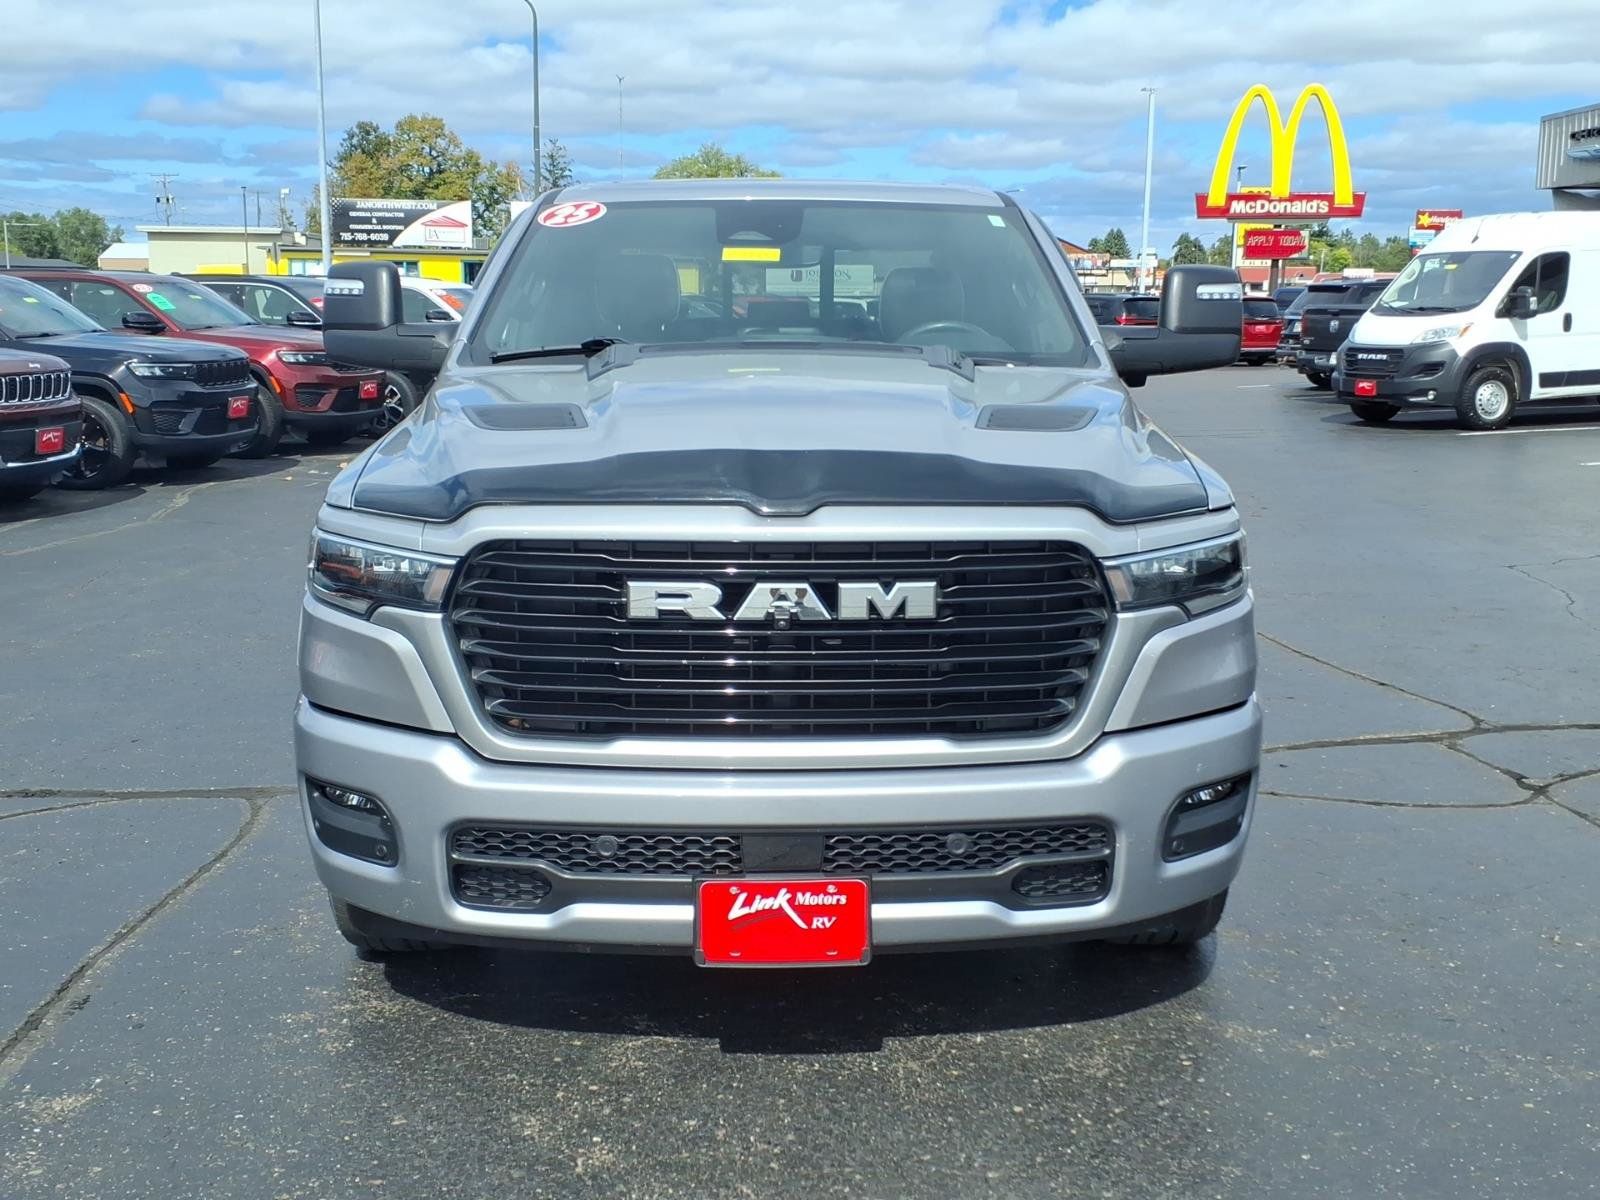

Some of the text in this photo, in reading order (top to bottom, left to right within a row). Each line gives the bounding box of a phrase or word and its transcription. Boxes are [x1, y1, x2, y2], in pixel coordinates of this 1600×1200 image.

[355, 201, 437, 210] JANORTHWEST.COM
[1230, 199, 1329, 214] McDonald's
[544, 203, 600, 225] 25
[339, 232, 389, 241] 715-768-6039
[1247, 236, 1274, 246] APPLY
[626, 580, 938, 621] RAM
[728, 887, 848, 930] Link Motors
[811, 916, 838, 929] RV
